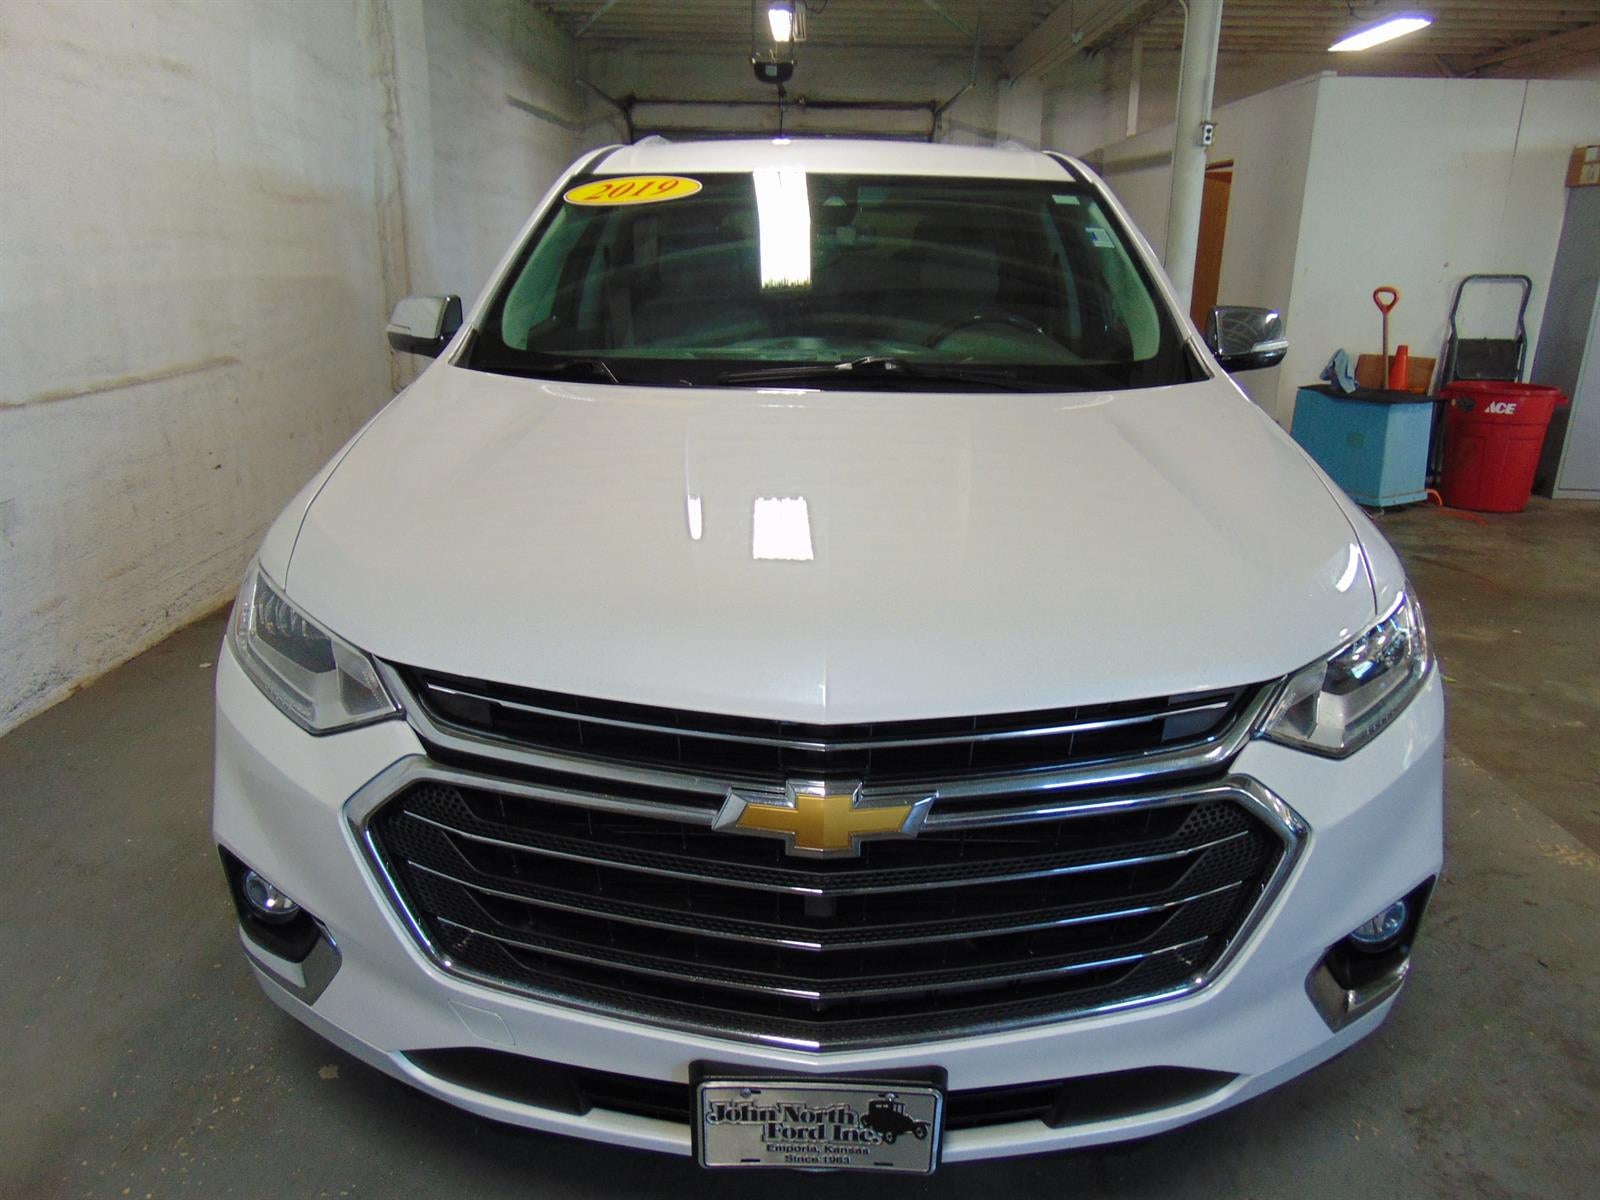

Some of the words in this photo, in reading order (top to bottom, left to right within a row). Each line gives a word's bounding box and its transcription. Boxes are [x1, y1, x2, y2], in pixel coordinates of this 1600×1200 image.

[584, 180, 680, 200] 2019
[1484, 401, 1517, 414] ACE
[710, 1103, 777, 1122] John
[782, 1103, 856, 1125] North
[766, 1121, 826, 1140] Ford
[784, 1153, 819, 1164] Since
